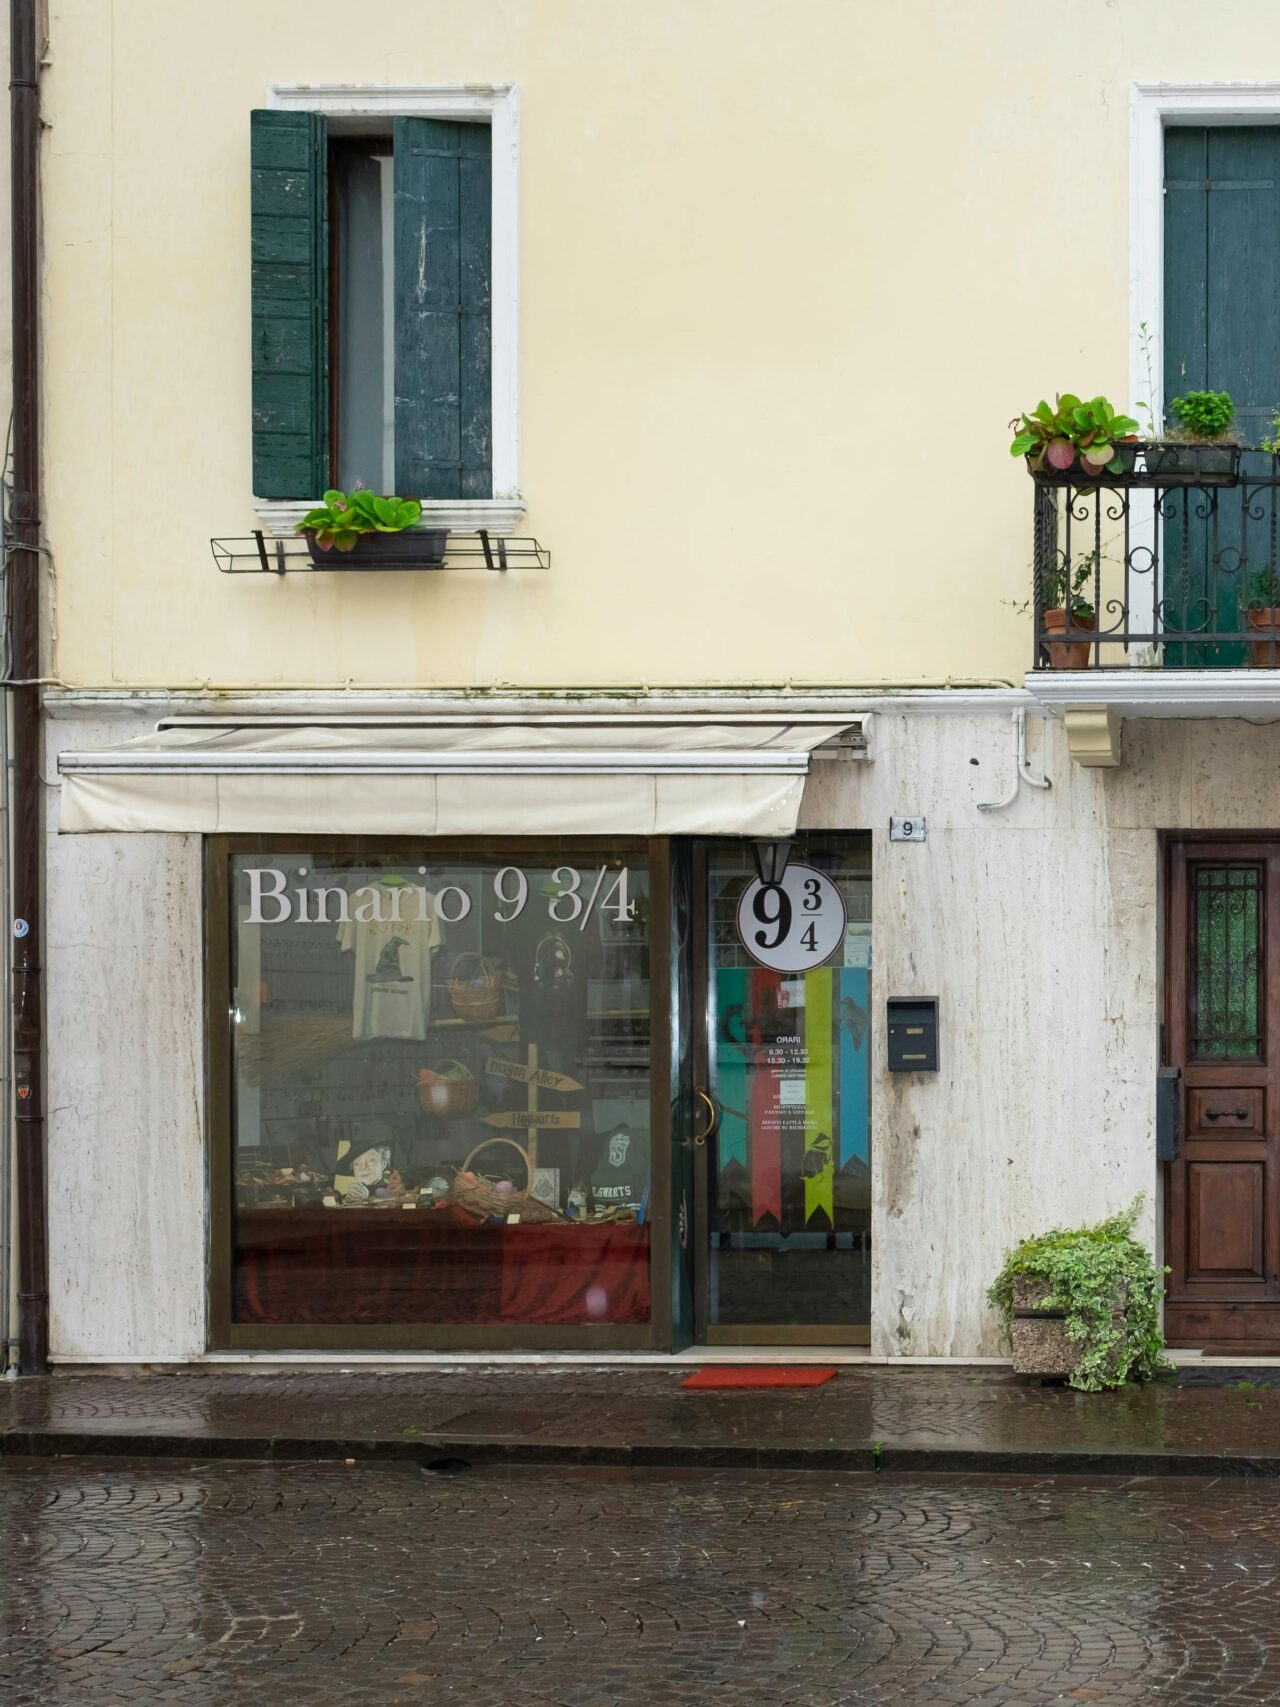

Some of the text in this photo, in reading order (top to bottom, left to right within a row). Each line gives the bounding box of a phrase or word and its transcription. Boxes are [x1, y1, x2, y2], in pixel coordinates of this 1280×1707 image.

[903, 822, 913, 836] 9
[243, 865, 635, 931] Binario 9 3/4
[753, 884, 792, 949] 9
[776, 1036, 801, 1044] ORARI
[529, 1070, 564, 1087] Alley
[592, 1186, 632, 1198] GWARTS
